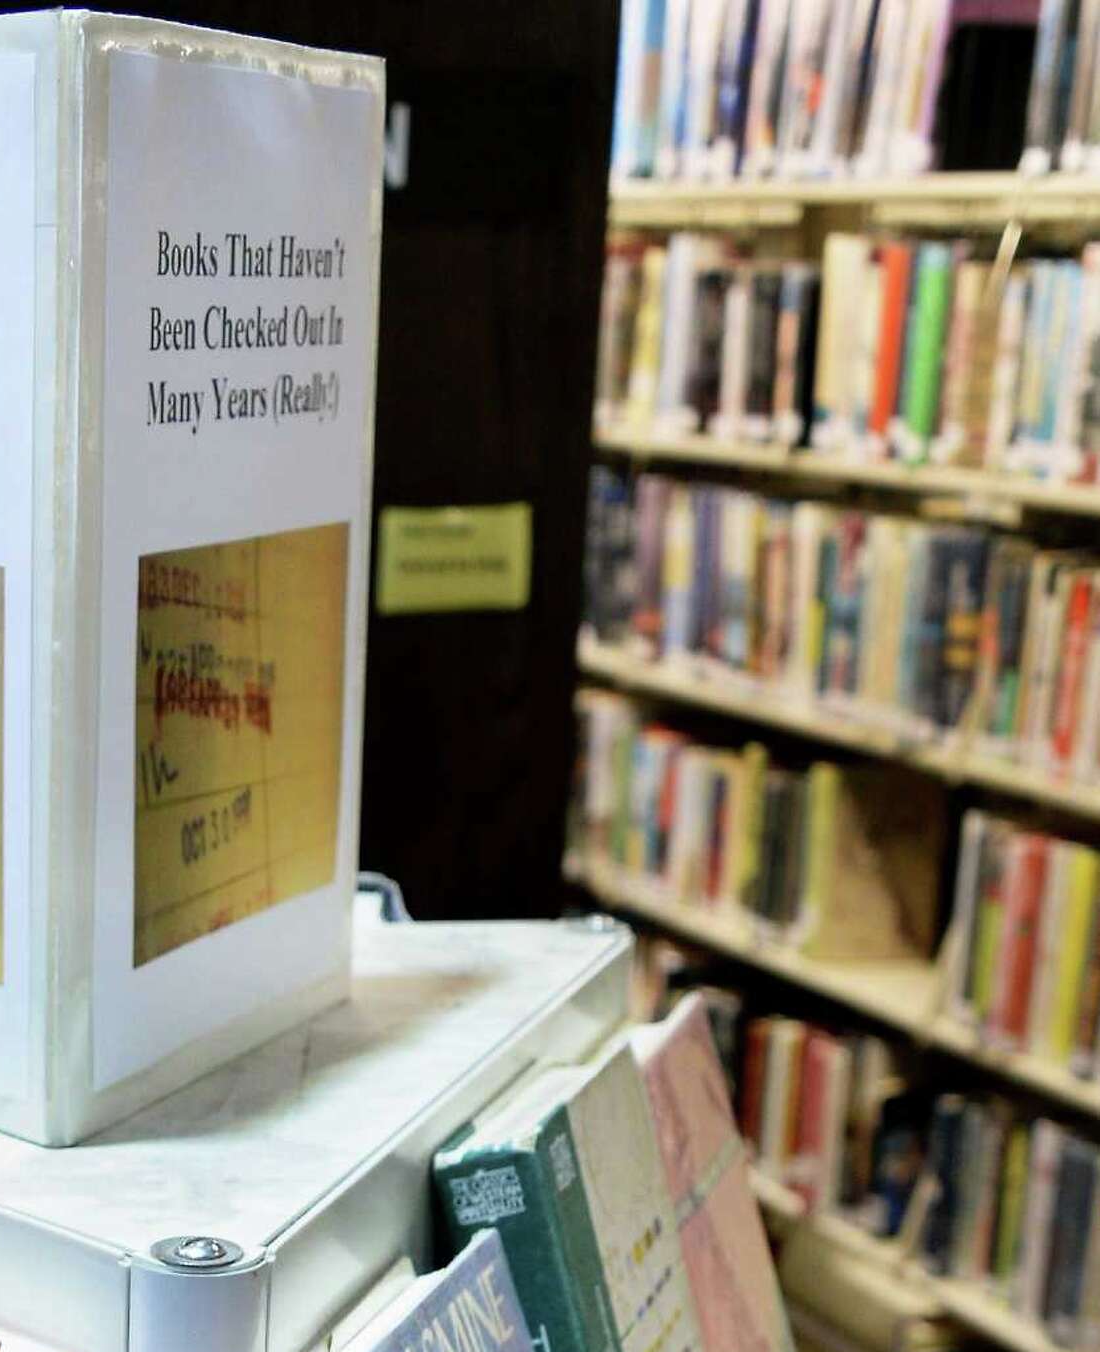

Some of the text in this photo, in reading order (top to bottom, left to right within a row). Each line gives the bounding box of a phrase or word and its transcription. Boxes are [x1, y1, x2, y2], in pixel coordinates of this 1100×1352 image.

[156, 230, 218, 277] Books
[225, 232, 273, 278] That
[149, 305, 196, 351] Been
[203, 304, 289, 351] Checked
[294, 304, 325, 348] Out
[147, 379, 204, 436] Many
[211, 376, 268, 421] Years
